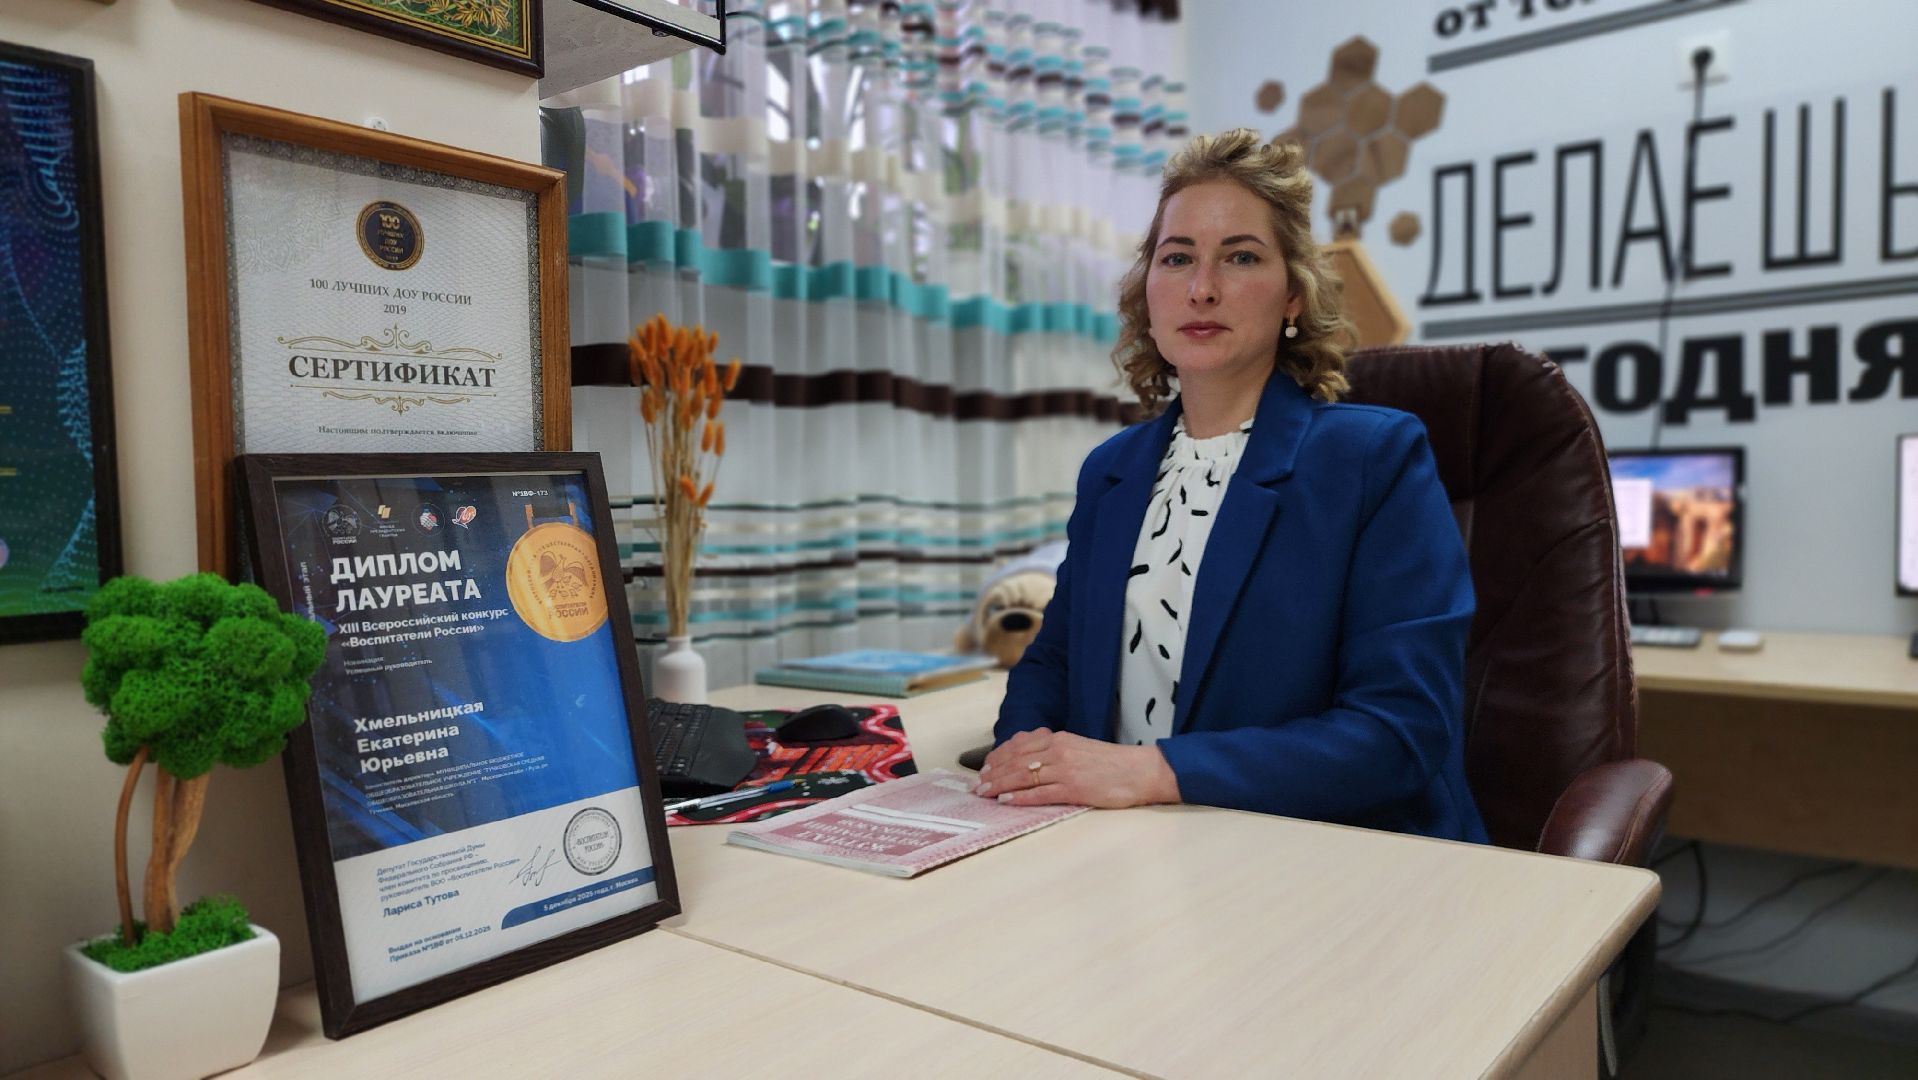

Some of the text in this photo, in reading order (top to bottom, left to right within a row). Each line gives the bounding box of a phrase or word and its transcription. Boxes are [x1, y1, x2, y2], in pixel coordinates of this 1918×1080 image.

[310, 278, 472, 305] 100 ЛУЧШИХ ДОУ РОССИИ
[383, 304, 407, 315] 2019
[288, 355, 496, 388] СЕРТИФИКАТ
[318, 426, 368, 434] Настоящим
[330, 550, 462, 585] ДИПЛОМ
[301, 585, 316, 623] альный
[335, 579, 482, 614] ЛАУРЕАТА
[338, 607, 509, 635] XIII Всероссийский конкурс
[548, 607, 589, 620] ОССИИ
[354, 701, 484, 734] Хмельницкая
[356, 724, 460, 754] Екатерина
[360, 745, 449, 774] Юрьевна
[376, 843, 486, 877] Депутат Государственной Думы
[378, 866, 429, 884] Федерального
[429, 857, 463, 871] Собрания
[380, 883, 430, 903] руководитель
[397, 874, 431, 888] комитета
[383, 889, 460, 918] Лариса Тутова
[577, 890, 594, 901] 2025
[388, 942, 413, 954] Выдан
[423, 927, 462, 942] основании
[389, 949, 421, 962] Приказа
